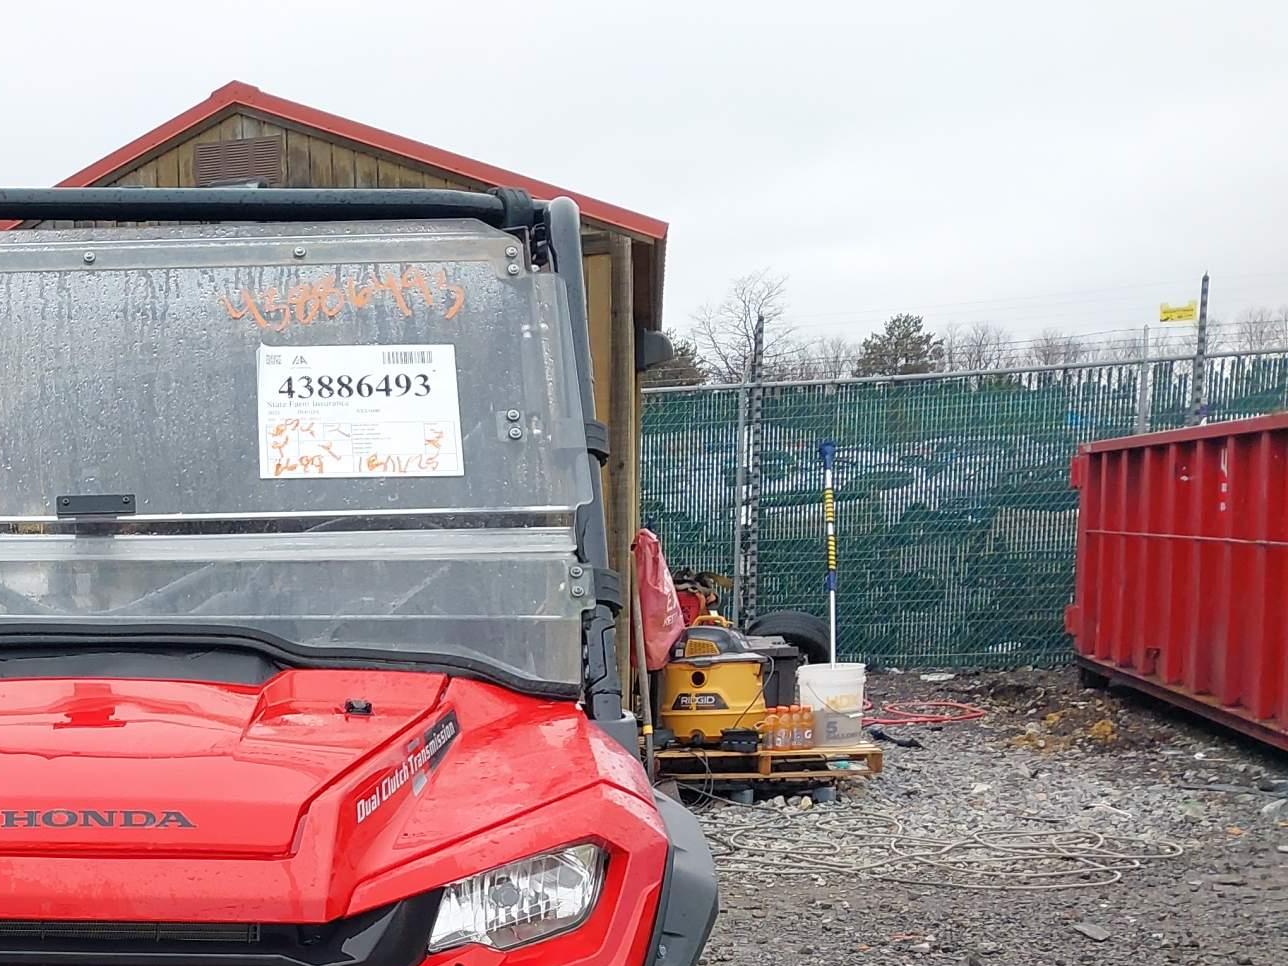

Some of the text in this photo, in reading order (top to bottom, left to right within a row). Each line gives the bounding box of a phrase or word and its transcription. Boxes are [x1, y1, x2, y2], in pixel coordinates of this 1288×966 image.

[278, 373, 432, 399] 43886493
[680, 695, 716, 705] RIDGID
[356, 720, 457, 825] Dual Clutch Transmission
[0, 809, 198, 829] HONDA
